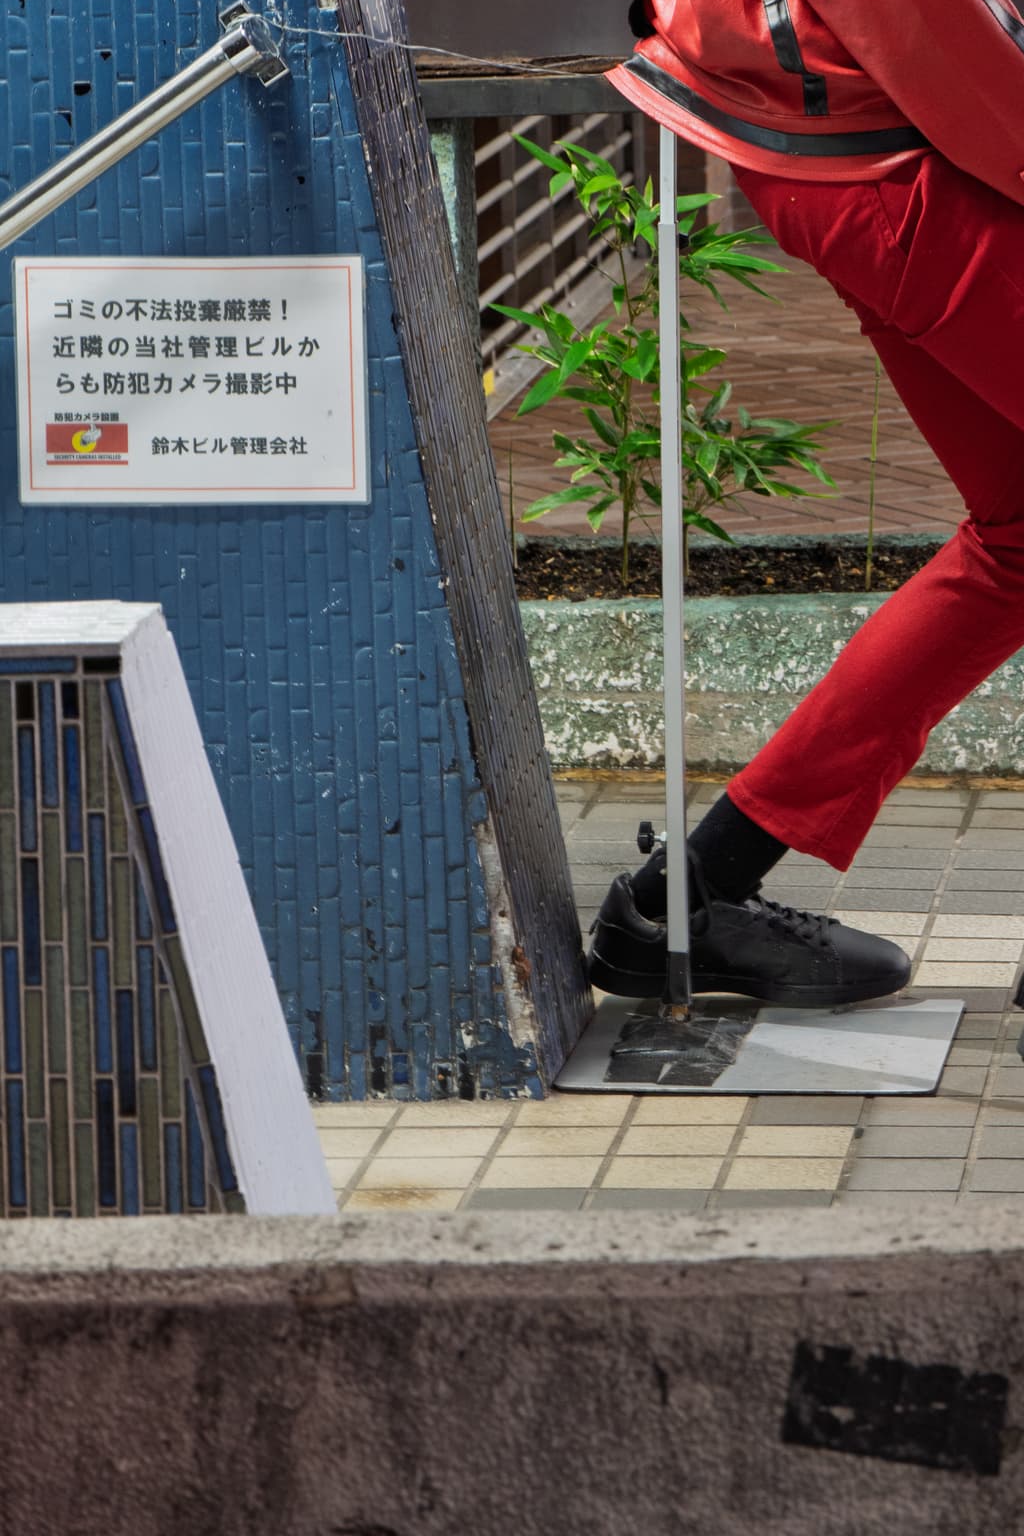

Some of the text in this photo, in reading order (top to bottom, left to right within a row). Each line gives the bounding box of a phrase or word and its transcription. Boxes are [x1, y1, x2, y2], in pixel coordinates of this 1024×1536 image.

[52, 335, 320, 359] 近隣の当社管理ビルか
[55, 372, 298, 396] らも防犯カメラ撮影中
[151, 436, 309, 456] 鈴木ビル管理会社
